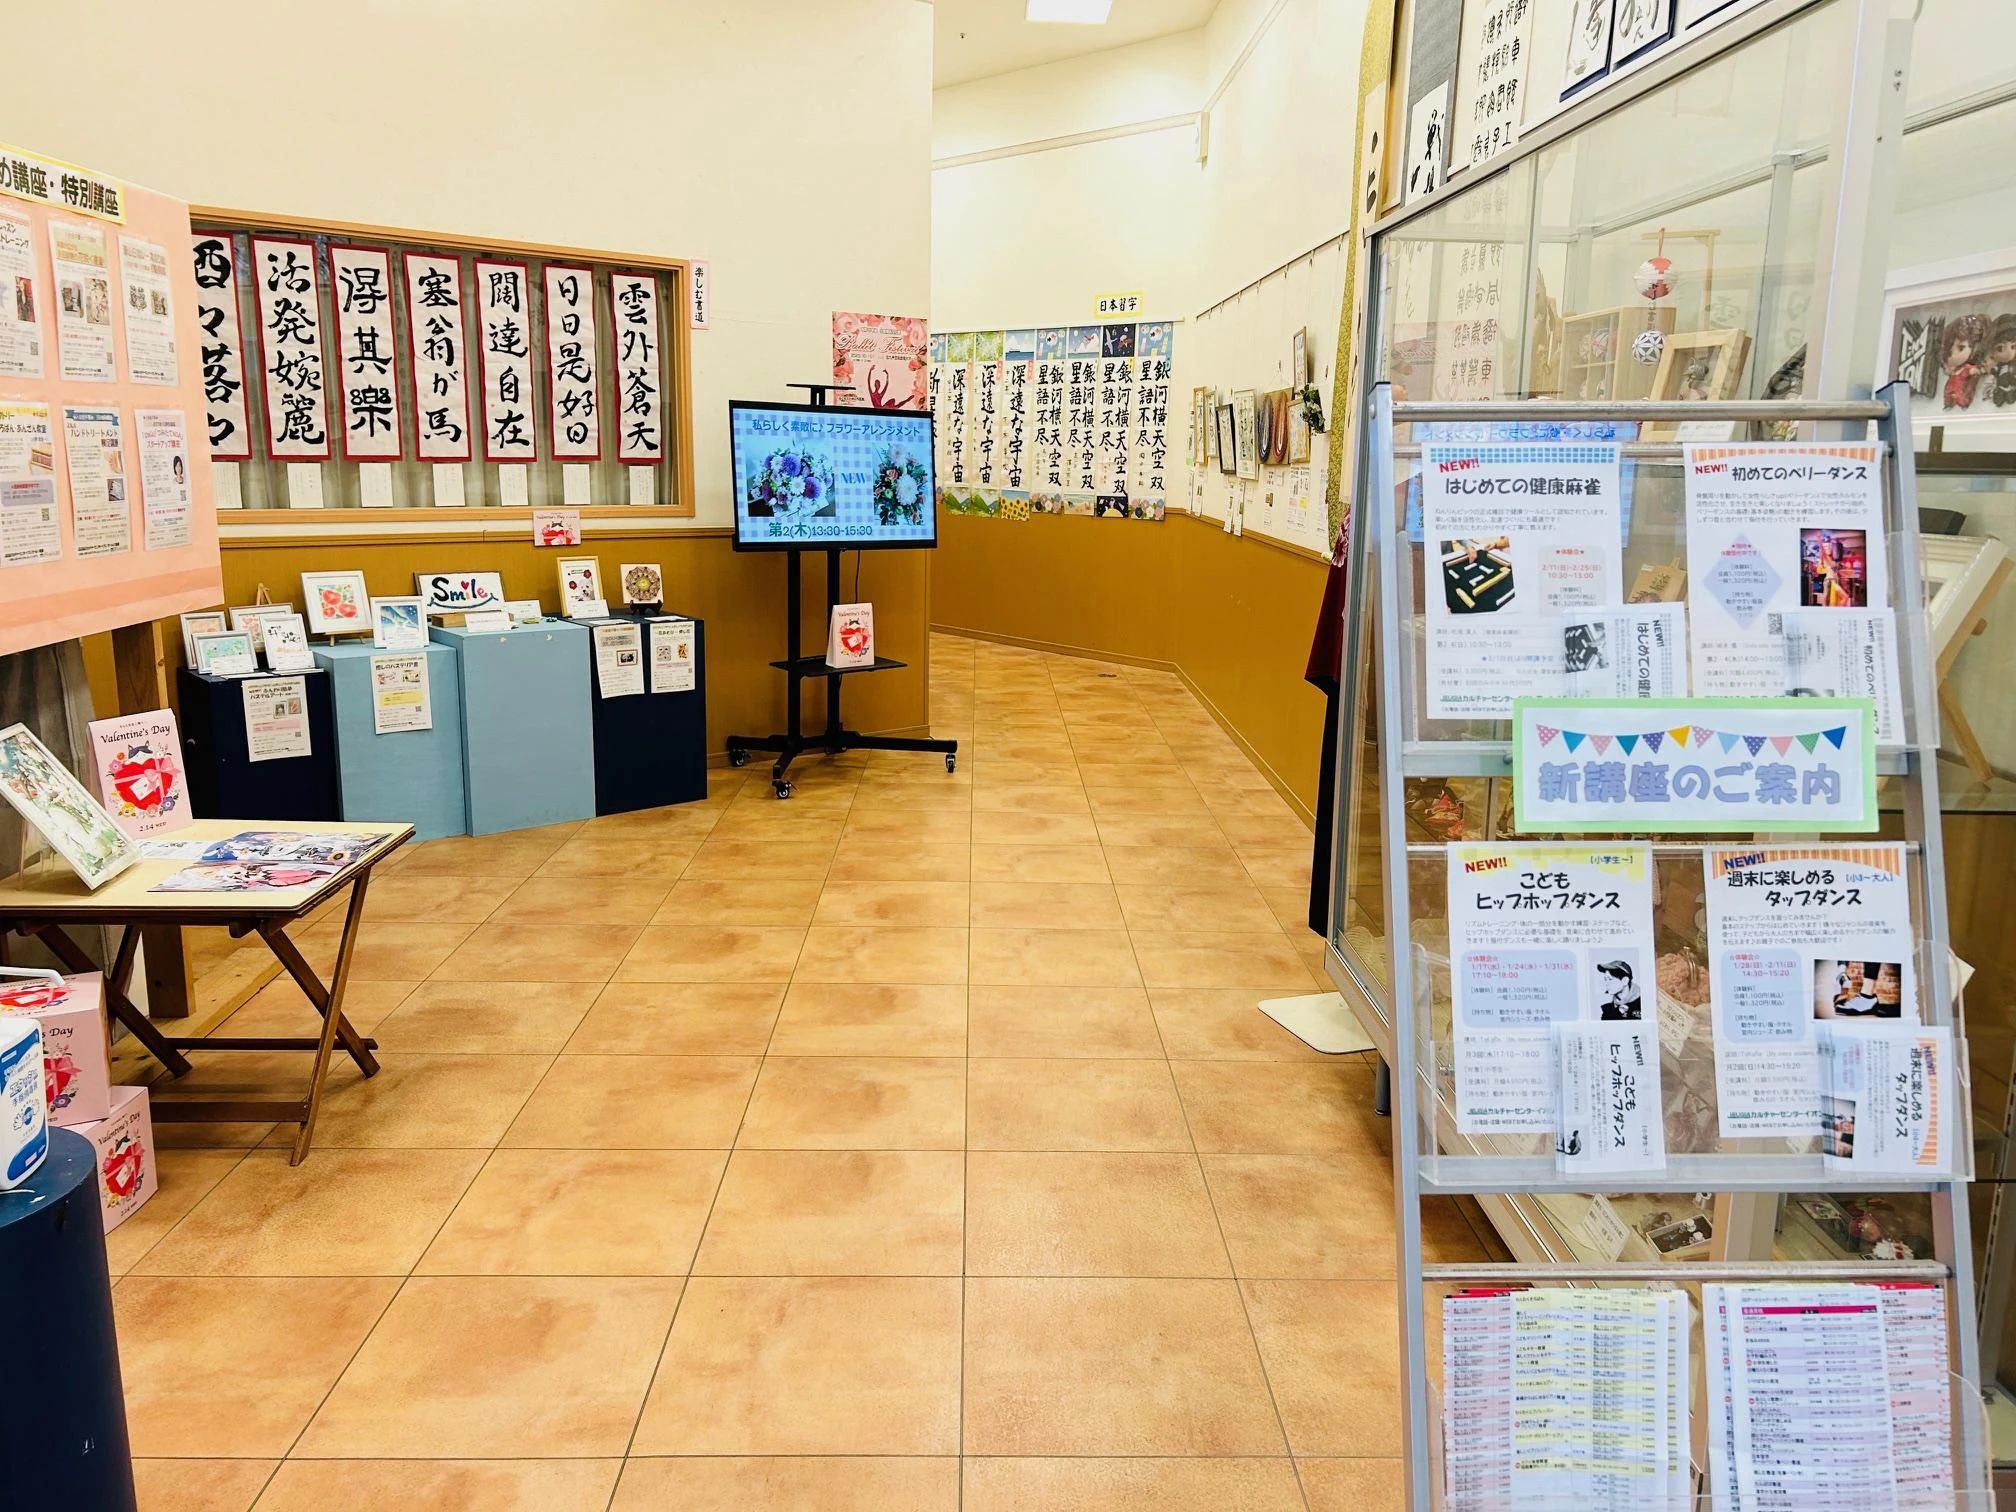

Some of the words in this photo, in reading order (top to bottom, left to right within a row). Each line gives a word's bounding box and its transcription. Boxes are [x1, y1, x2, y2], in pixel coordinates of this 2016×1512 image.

[694, 266, 704, 323] 楽しむ書道
[1100, 297, 1138, 312] 日本習字
[417, 266, 462, 443] 塞翁が馬
[556, 275, 595, 445] 日日是好日
[618, 282, 658, 451] 雲外蒼天
[952, 368, 966, 483] 深遠な宇宙
[980, 364, 997, 484] 深遠な宇宙
[1009, 364, 1026, 488] 深遠な宇宙
[1439, 458, 1480, 473] NEW!!
[1695, 464, 1728, 474] NEW!!
[1731, 466, 1868, 482] 初めてのベリーダンス
[1445, 477, 1601, 496] はじめての健康麻雀
[432, 577, 488, 602] Smile
[101, 728, 149, 744] Valentine's
[151, 725, 171, 736] Day
[1538, 761, 1841, 805] 新講座のご案内
[139, 824, 154, 832] 2.14
[1465, 856, 1507, 873] NEW!!
[1723, 852, 1766, 870] NEW!!
[1520, 872, 1570, 889] こども
[1727, 869, 1835, 887] 週末に楽しめる
[1477, 892, 1621, 910] ヒップホップダンス
[1765, 888, 1862, 907] タップダンス
[50, 1027, 74, 1038] Day
[1624, 1074, 1637, 1111] こども
[130, 1111, 141, 1124] Day
